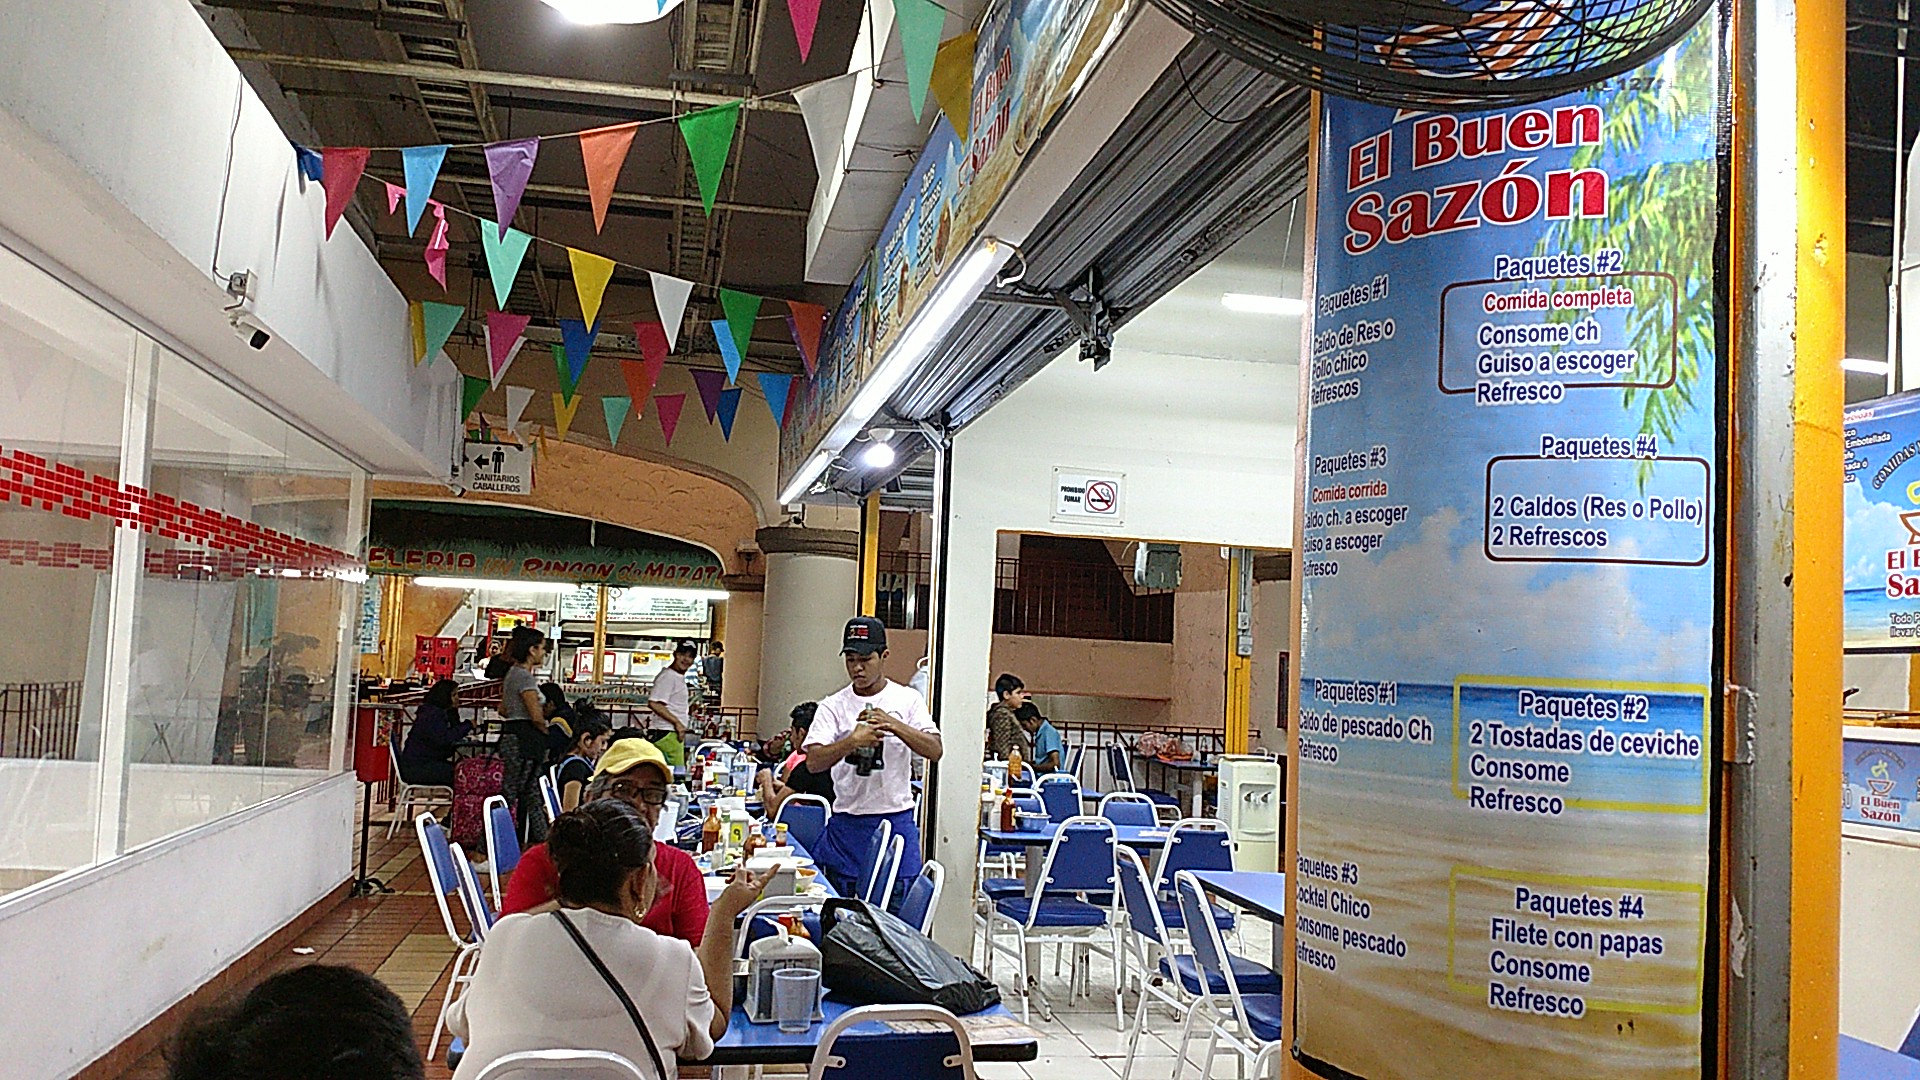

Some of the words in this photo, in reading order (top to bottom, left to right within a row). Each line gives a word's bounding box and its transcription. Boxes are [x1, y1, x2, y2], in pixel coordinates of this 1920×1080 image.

[1348, 133, 1390, 190] El
[1413, 106, 1600, 169] Buen
[1345, 157, 1609, 255] Sazón
[1495, 253, 1590, 279] Paquetes
[1597, 250, 1622, 273] #2
[1318, 285, 1369, 316] Paquetes
[1372, 276, 1389, 299] #1
[1483, 291, 1548, 313] Comida
[1553, 288, 1632, 312] completa
[1313, 330, 1336, 355] Caldo
[1338, 326, 1353, 346] de
[1356, 322, 1381, 343] Res
[1384, 321, 1394, 337] o
[1479, 324, 1570, 348] Consome
[1575, 321, 1598, 342] ch
[1312, 356, 1332, 379] Pollo
[1334, 352, 1367, 374] chico
[1478, 351, 1534, 374] Guiso
[1539, 355, 1551, 371] a
[1556, 349, 1635, 376] escoger
[1311, 380, 1359, 406] Refrescos
[1478, 382, 1563, 402] Refresco
[1541, 435, 1631, 460] Paquetes
[1636, 436, 1658, 456] #4
[1845, 433, 1891, 449] Embotellada
[1314, 451, 1367, 477] Paquetes
[1370, 446, 1387, 467] #3
[1873, 443, 1916, 489] COMIDAS
[472, 482, 521, 493] CABALLEROS
[474, 473, 520, 483] SANITARIOS
[1060, 485, 1086, 494] PROHIBIDO
[1063, 495, 1081, 503] FUMAR
[1312, 485, 1346, 504] Comida
[1348, 480, 1387, 499] corrida
[1326, 508, 1343, 526] ch.
[1345, 511, 1352, 525] a
[1355, 506, 1408, 527] escoger
[1493, 497, 1504, 516] 2
[1509, 496, 1577, 517] Caldos
[1583, 495, 1626, 522] (Res
[1632, 501, 1644, 517] o
[1649, 498, 1703, 526] Pollo)
[1325, 538, 1332, 551] a
[1335, 533, 1383, 553] escoger
[1492, 526, 1504, 546] 2
[1509, 525, 1607, 546] Refrescos
[520, 558, 615, 582] RINCON
[1303, 560, 1338, 577] Refresco
[1887, 550, 1905, 570] El
[1890, 612, 1912, 624] Todo
[1890, 626, 1915, 637] llevar
[1315, 679, 1375, 705] Paquetes
[1379, 682, 1396, 703] #1
[1520, 692, 1617, 722] Paquetes
[1623, 696, 1648, 720] #2
[1299, 709, 1320, 731] Caldo
[1322, 712, 1338, 733] de
[1341, 716, 1403, 739] pescado
[1408, 718, 1432, 741] Ch
[1298, 737, 1338, 762] Refresco
[1470, 722, 1482, 745] 2
[1489, 723, 1583, 751] Tostadas
[1589, 729, 1615, 752] de
[1620, 731, 1699, 756] ceviche
[1470, 754, 1570, 782] Consome
[1470, 786, 1563, 815] Refresco
[1861, 796, 1870, 806] El
[1873, 797, 1900, 809] Buen
[1861, 806, 1901, 823] Sazón
[733, 828, 741, 840] 9
[1341, 861, 1358, 885] #3
[1331, 891, 1371, 919] Chico
[1515, 887, 1613, 919] Paquetes
[1619, 894, 1644, 918] #4
[1296, 909, 1339, 942] onsome
[1342, 933, 1407, 958] pescado
[1491, 917, 1548, 946] Filete
[1554, 929, 1593, 949] con
[1599, 933, 1664, 958] papas
[1296, 938, 1336, 971] efresco
[1491, 950, 1591, 983] Consome
[1490, 982, 1584, 1016] Refresco
